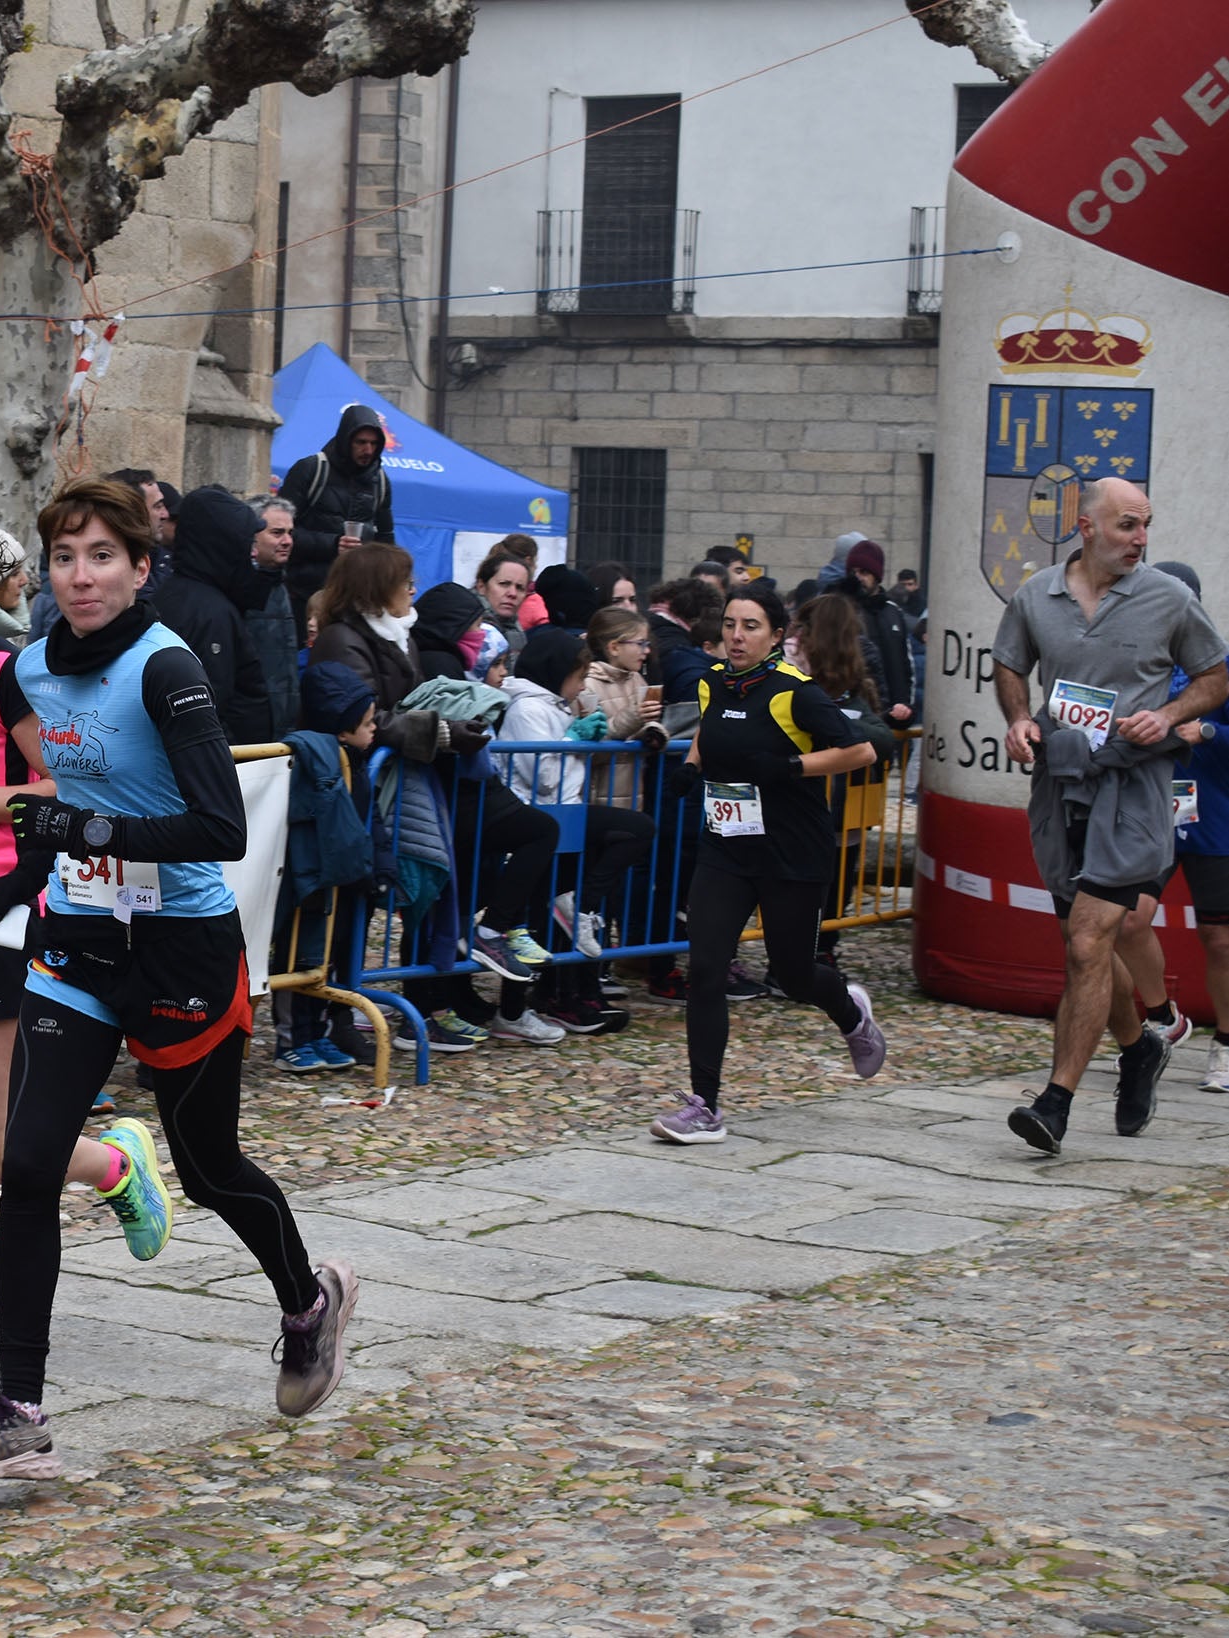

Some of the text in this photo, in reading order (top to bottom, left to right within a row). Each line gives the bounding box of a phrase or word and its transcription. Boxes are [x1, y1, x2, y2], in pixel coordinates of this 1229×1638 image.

[1067, 116, 1189, 236] CON
[1059, 701, 1110, 731] 1092
[926, 723, 946, 763] de
[56, 752, 100, 772] FLOWERS
[35, 806, 48, 835] MEDIA
[713, 800, 742, 822] 391
[135, 894, 152, 904] 541
